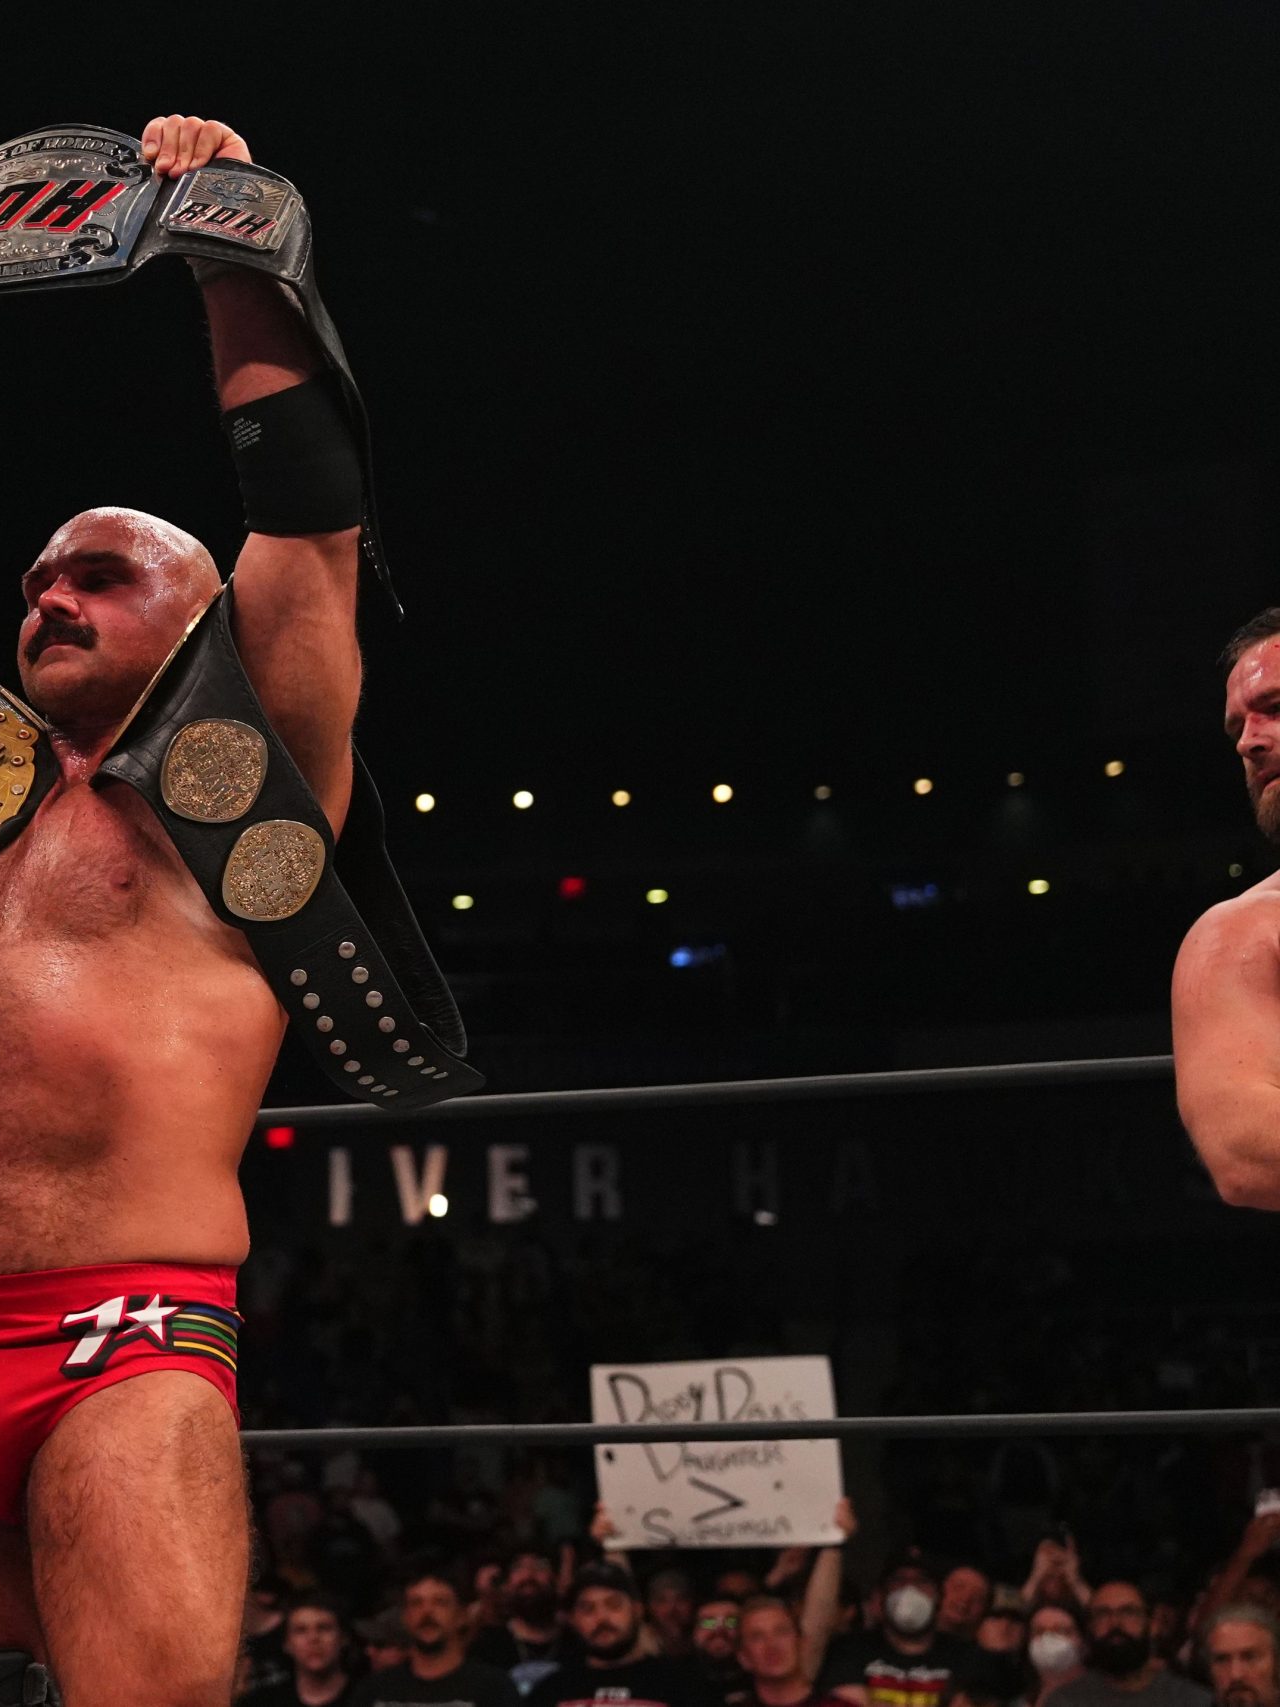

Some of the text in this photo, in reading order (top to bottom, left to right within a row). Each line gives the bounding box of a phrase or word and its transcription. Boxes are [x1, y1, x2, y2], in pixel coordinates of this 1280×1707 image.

[12, 139, 42, 157] OF
[42, 136, 117, 156] HONOR
[170, 200, 279, 239] ROH
